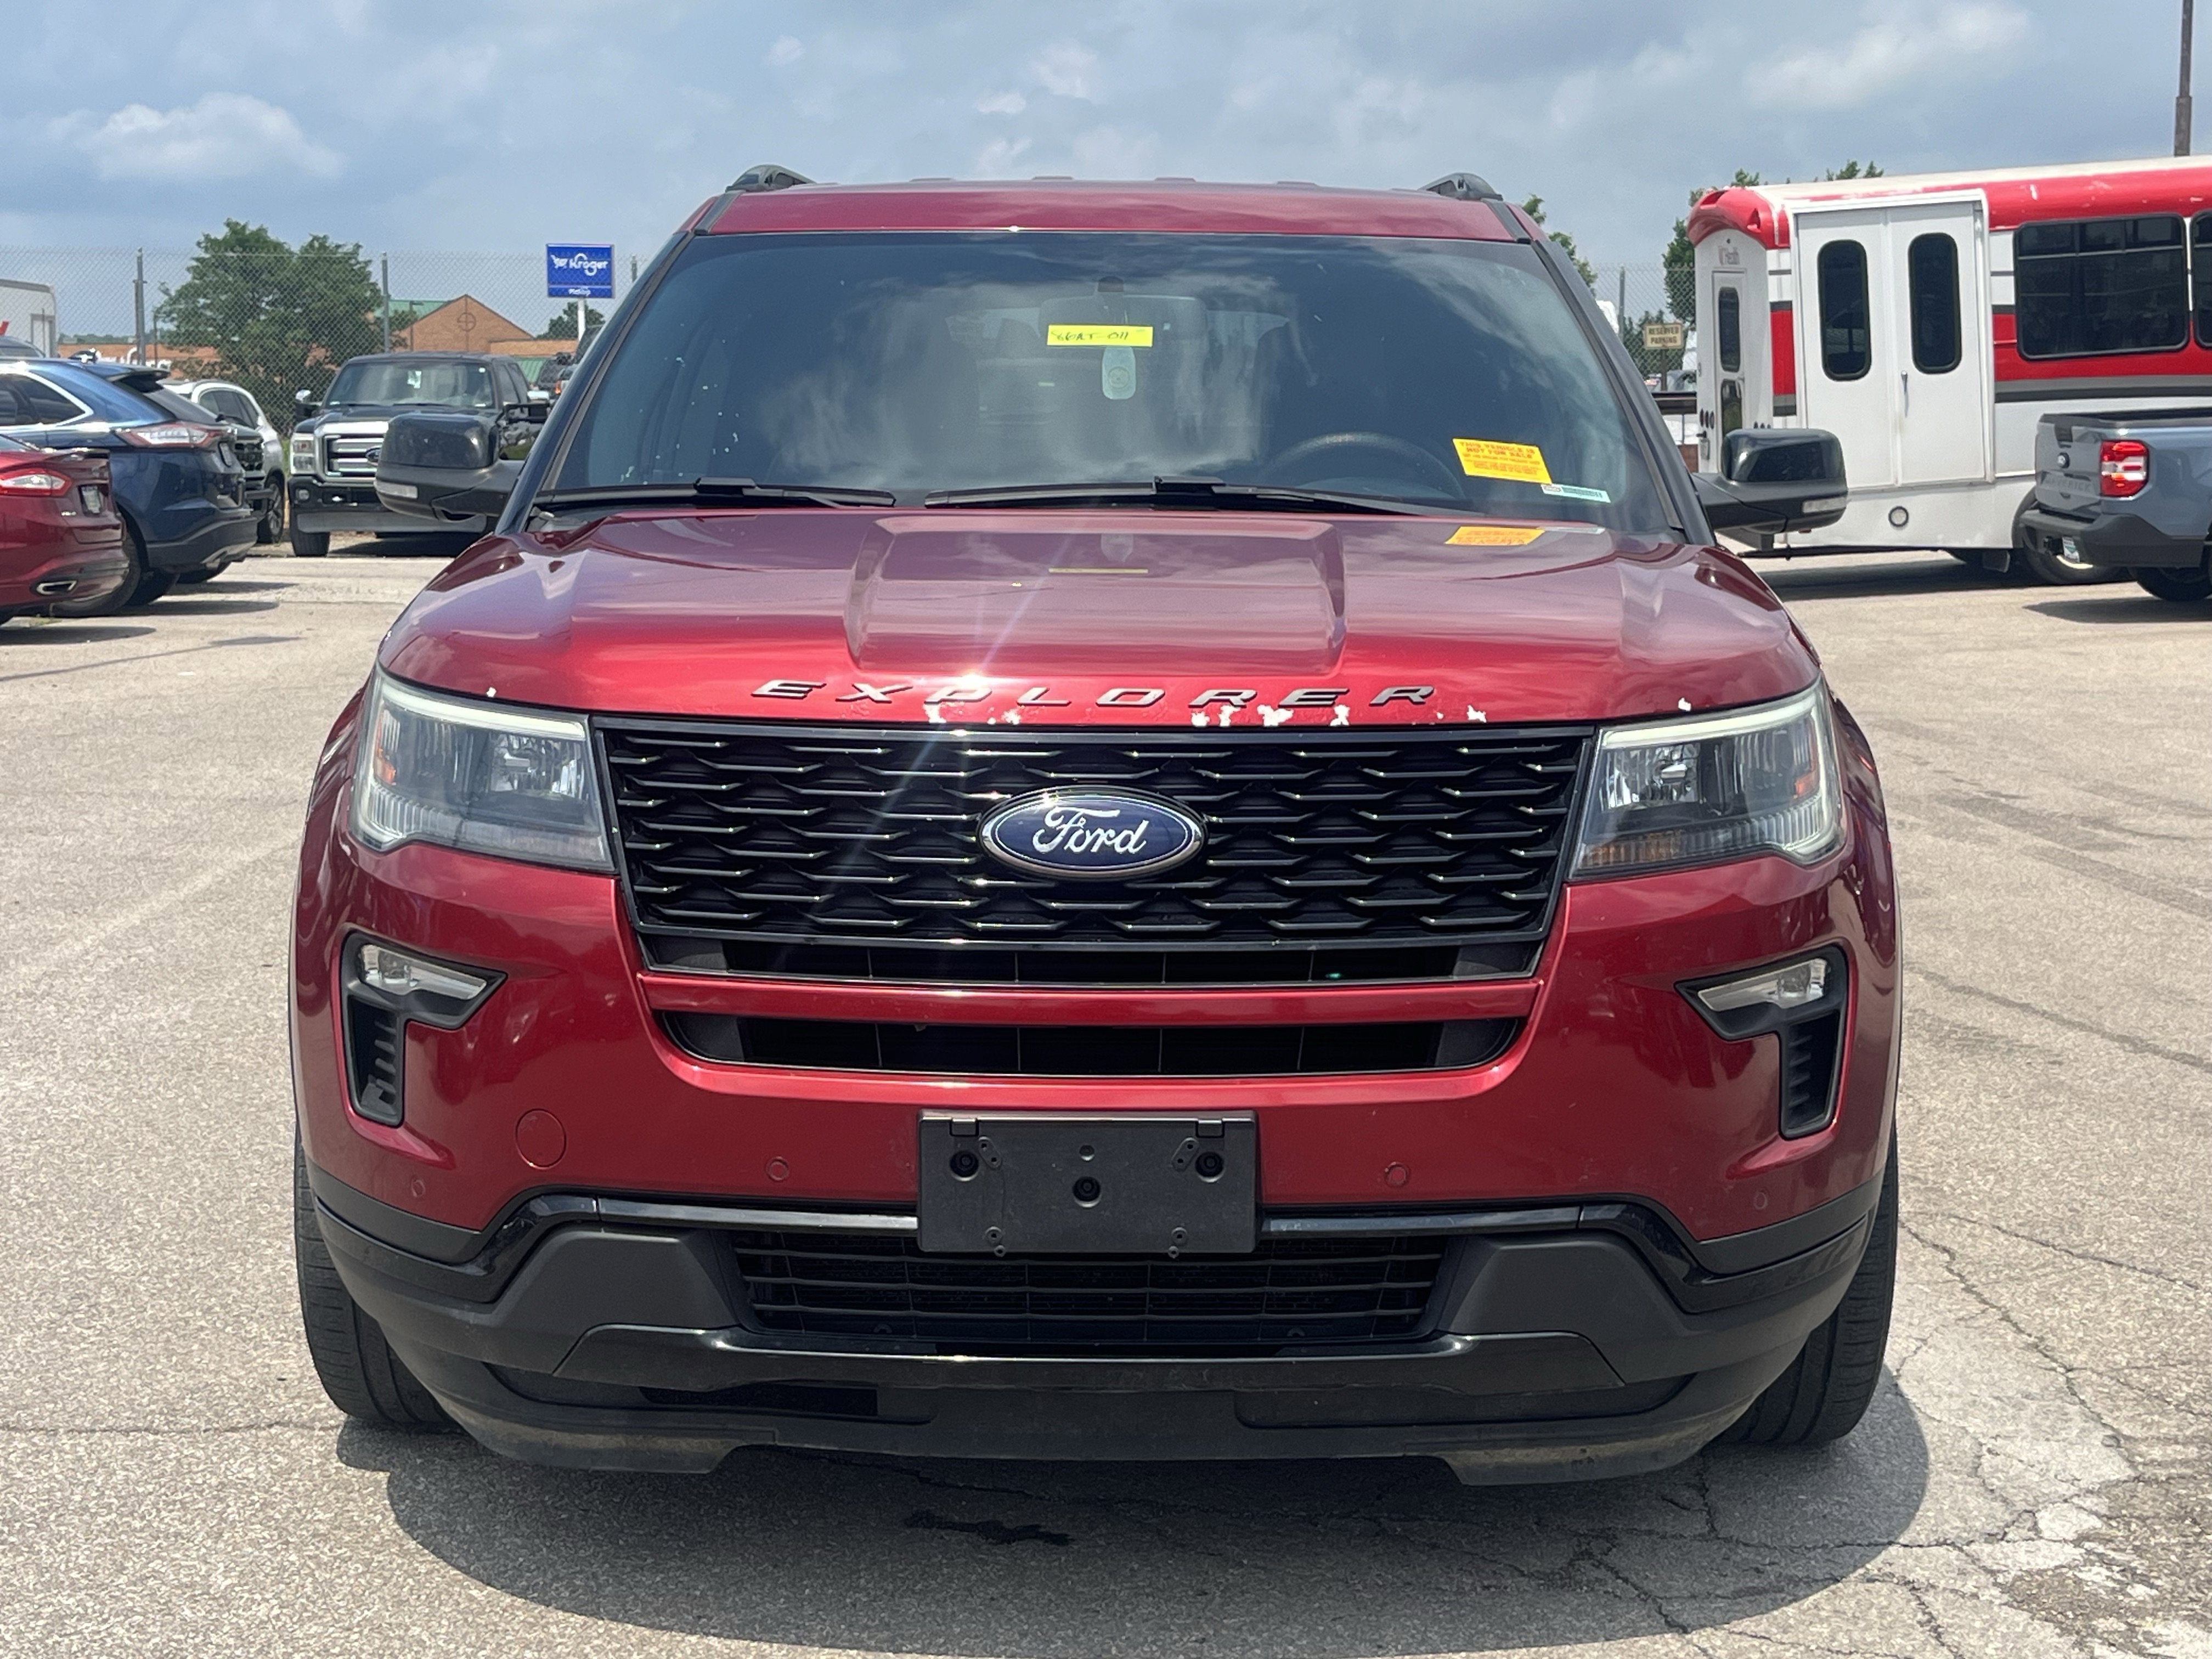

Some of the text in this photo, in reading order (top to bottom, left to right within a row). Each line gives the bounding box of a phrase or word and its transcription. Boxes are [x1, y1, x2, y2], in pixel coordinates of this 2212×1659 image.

[569, 253, 608, 276] Kroger
[1651, 336, 1677, 344] PARKING
[752, 679, 1435, 708] EXPLORER
[1032, 806, 1149, 854] Ford
